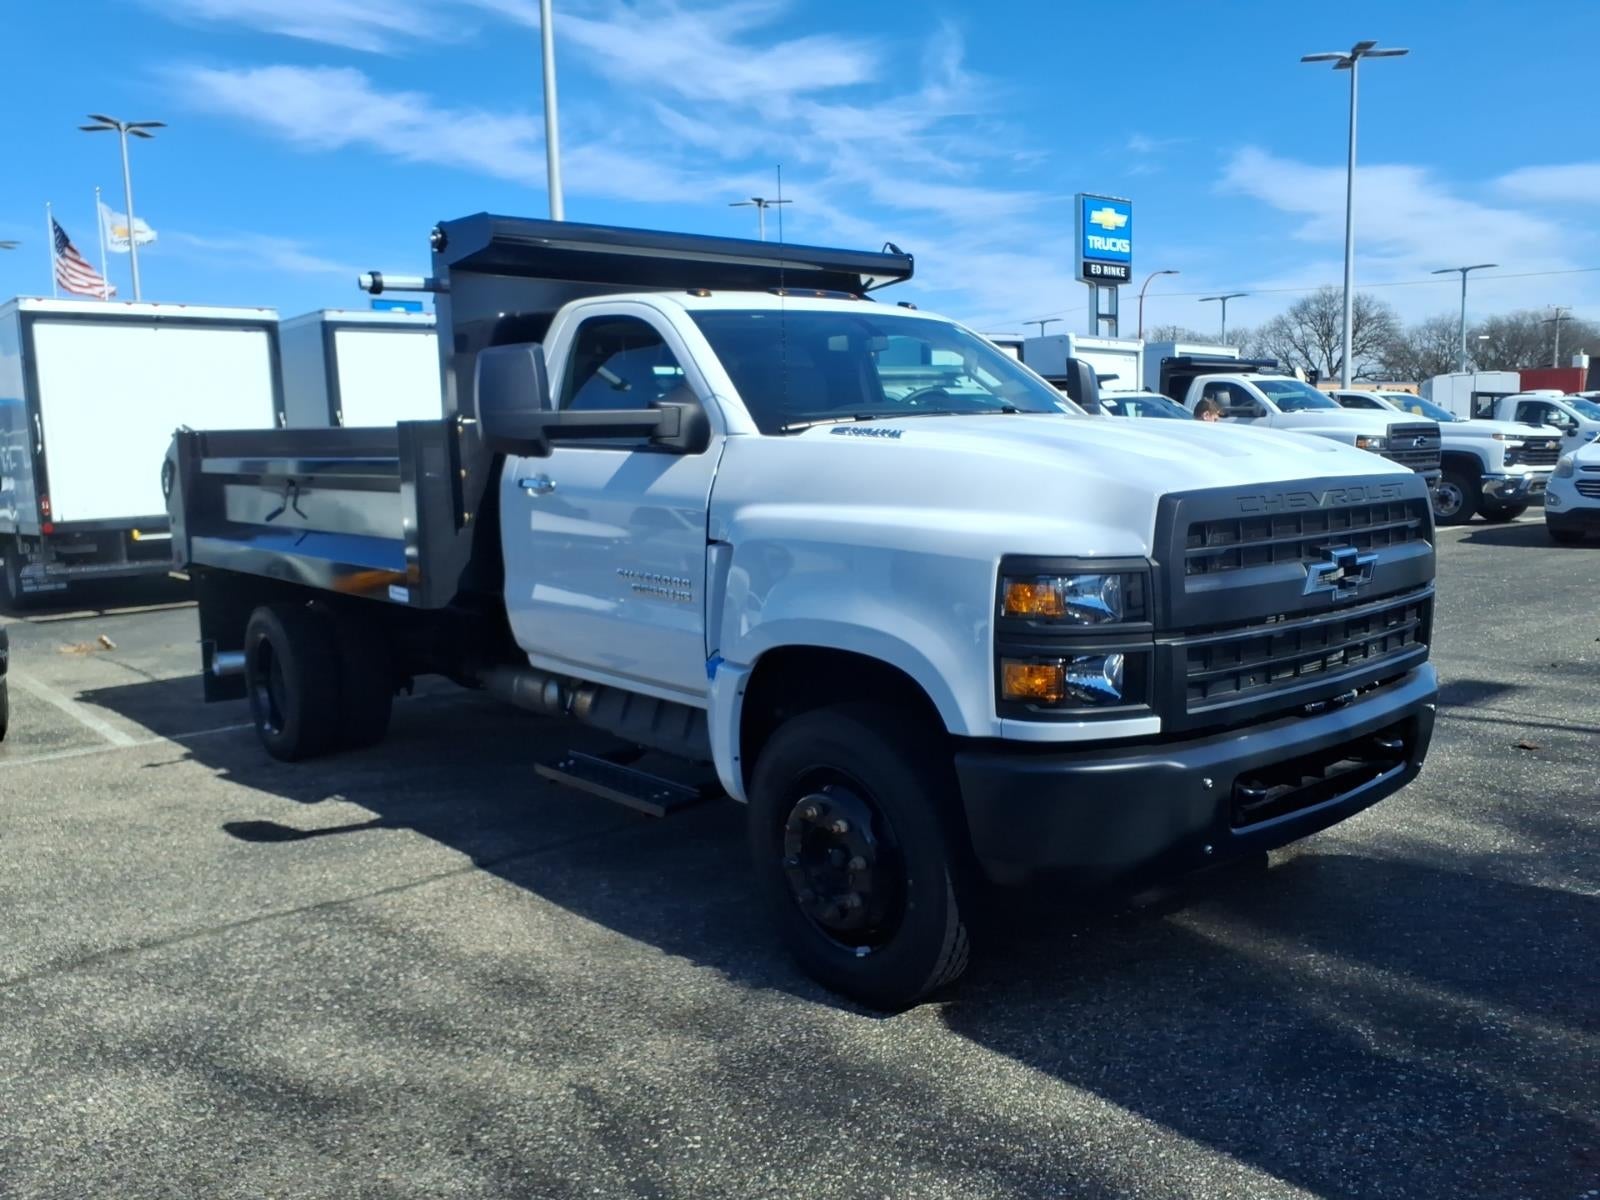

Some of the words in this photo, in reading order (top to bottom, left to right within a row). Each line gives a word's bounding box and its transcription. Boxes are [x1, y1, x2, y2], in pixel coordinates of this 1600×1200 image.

[1087, 235, 1130, 253] TRUCKS
[1090, 264, 1102, 275] ED
[1103, 266, 1126, 277] RINKE
[1236, 481, 1405, 513] CHEVROLET
